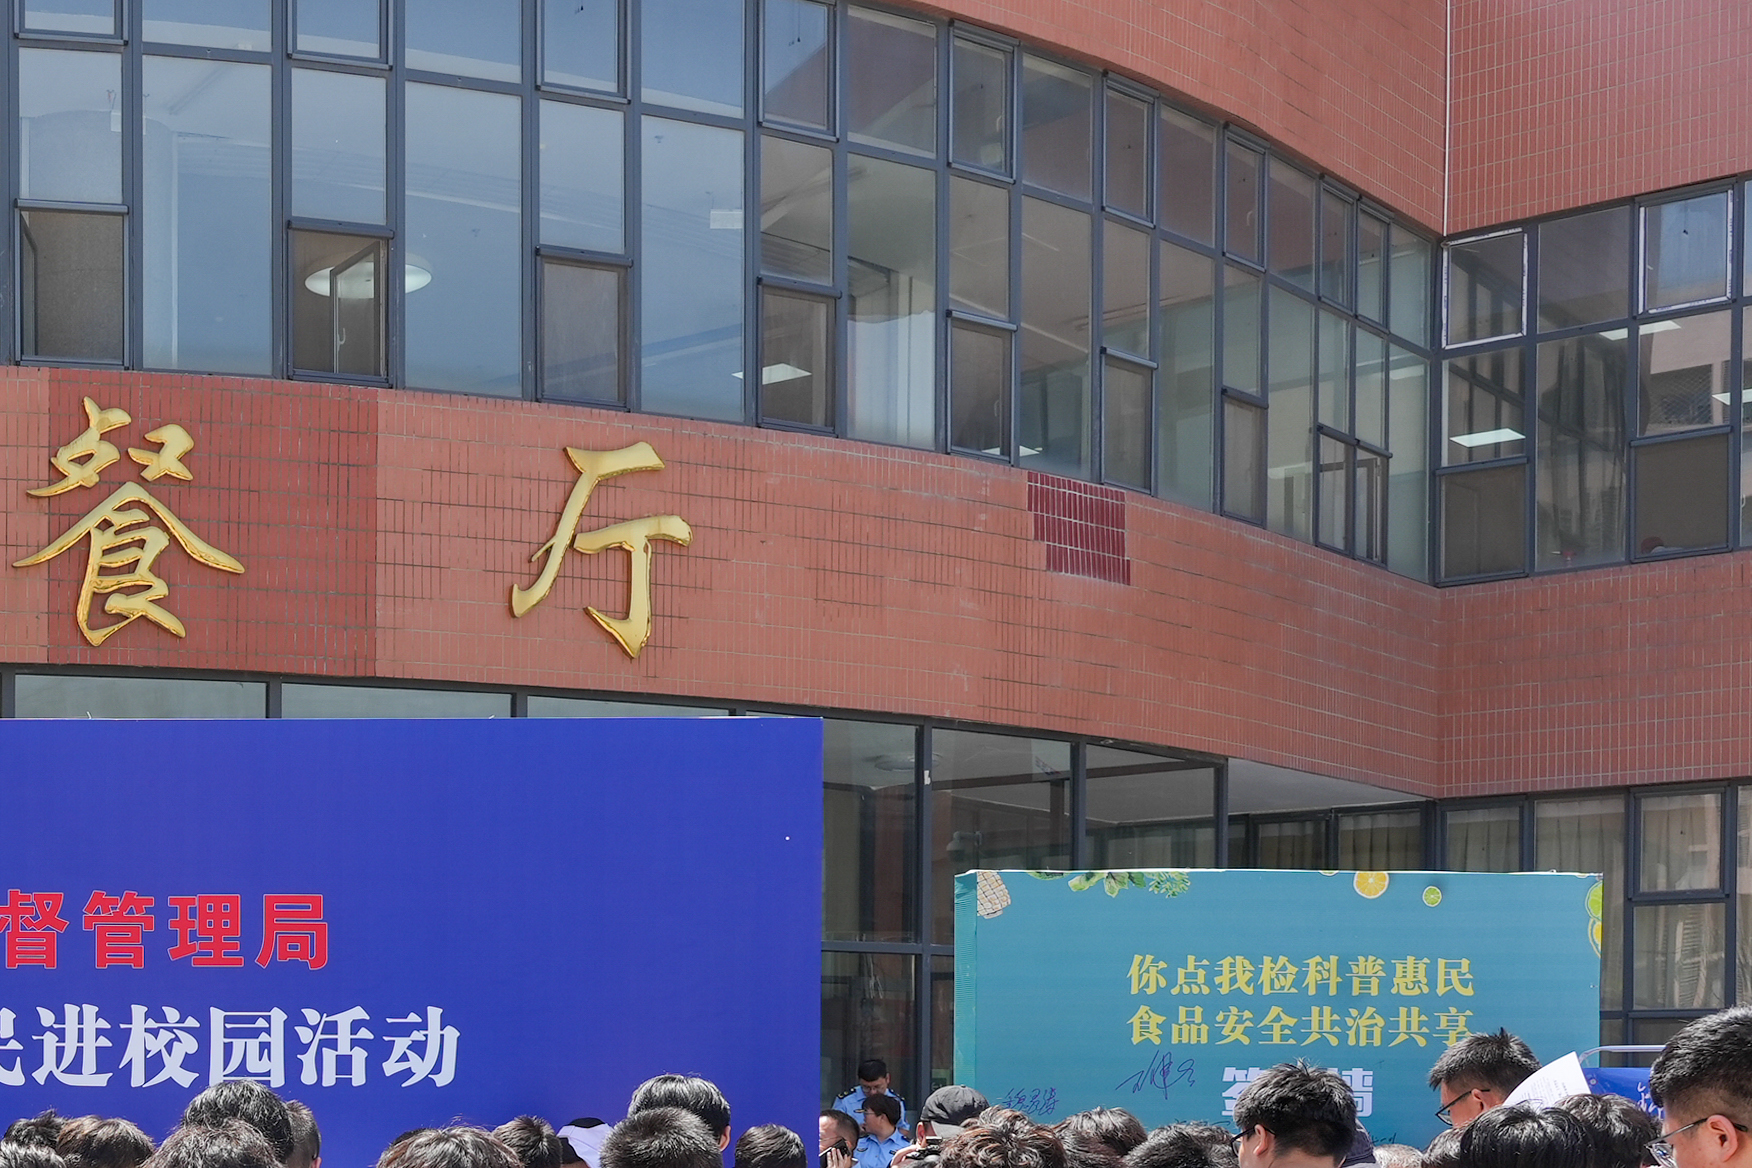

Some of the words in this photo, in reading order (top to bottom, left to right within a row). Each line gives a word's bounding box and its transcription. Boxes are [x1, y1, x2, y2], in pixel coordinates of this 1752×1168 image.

[1125, 953, 1476, 998] 你点我检科普惠民
[1125, 1004, 1476, 1048] 食品安全共治共享
